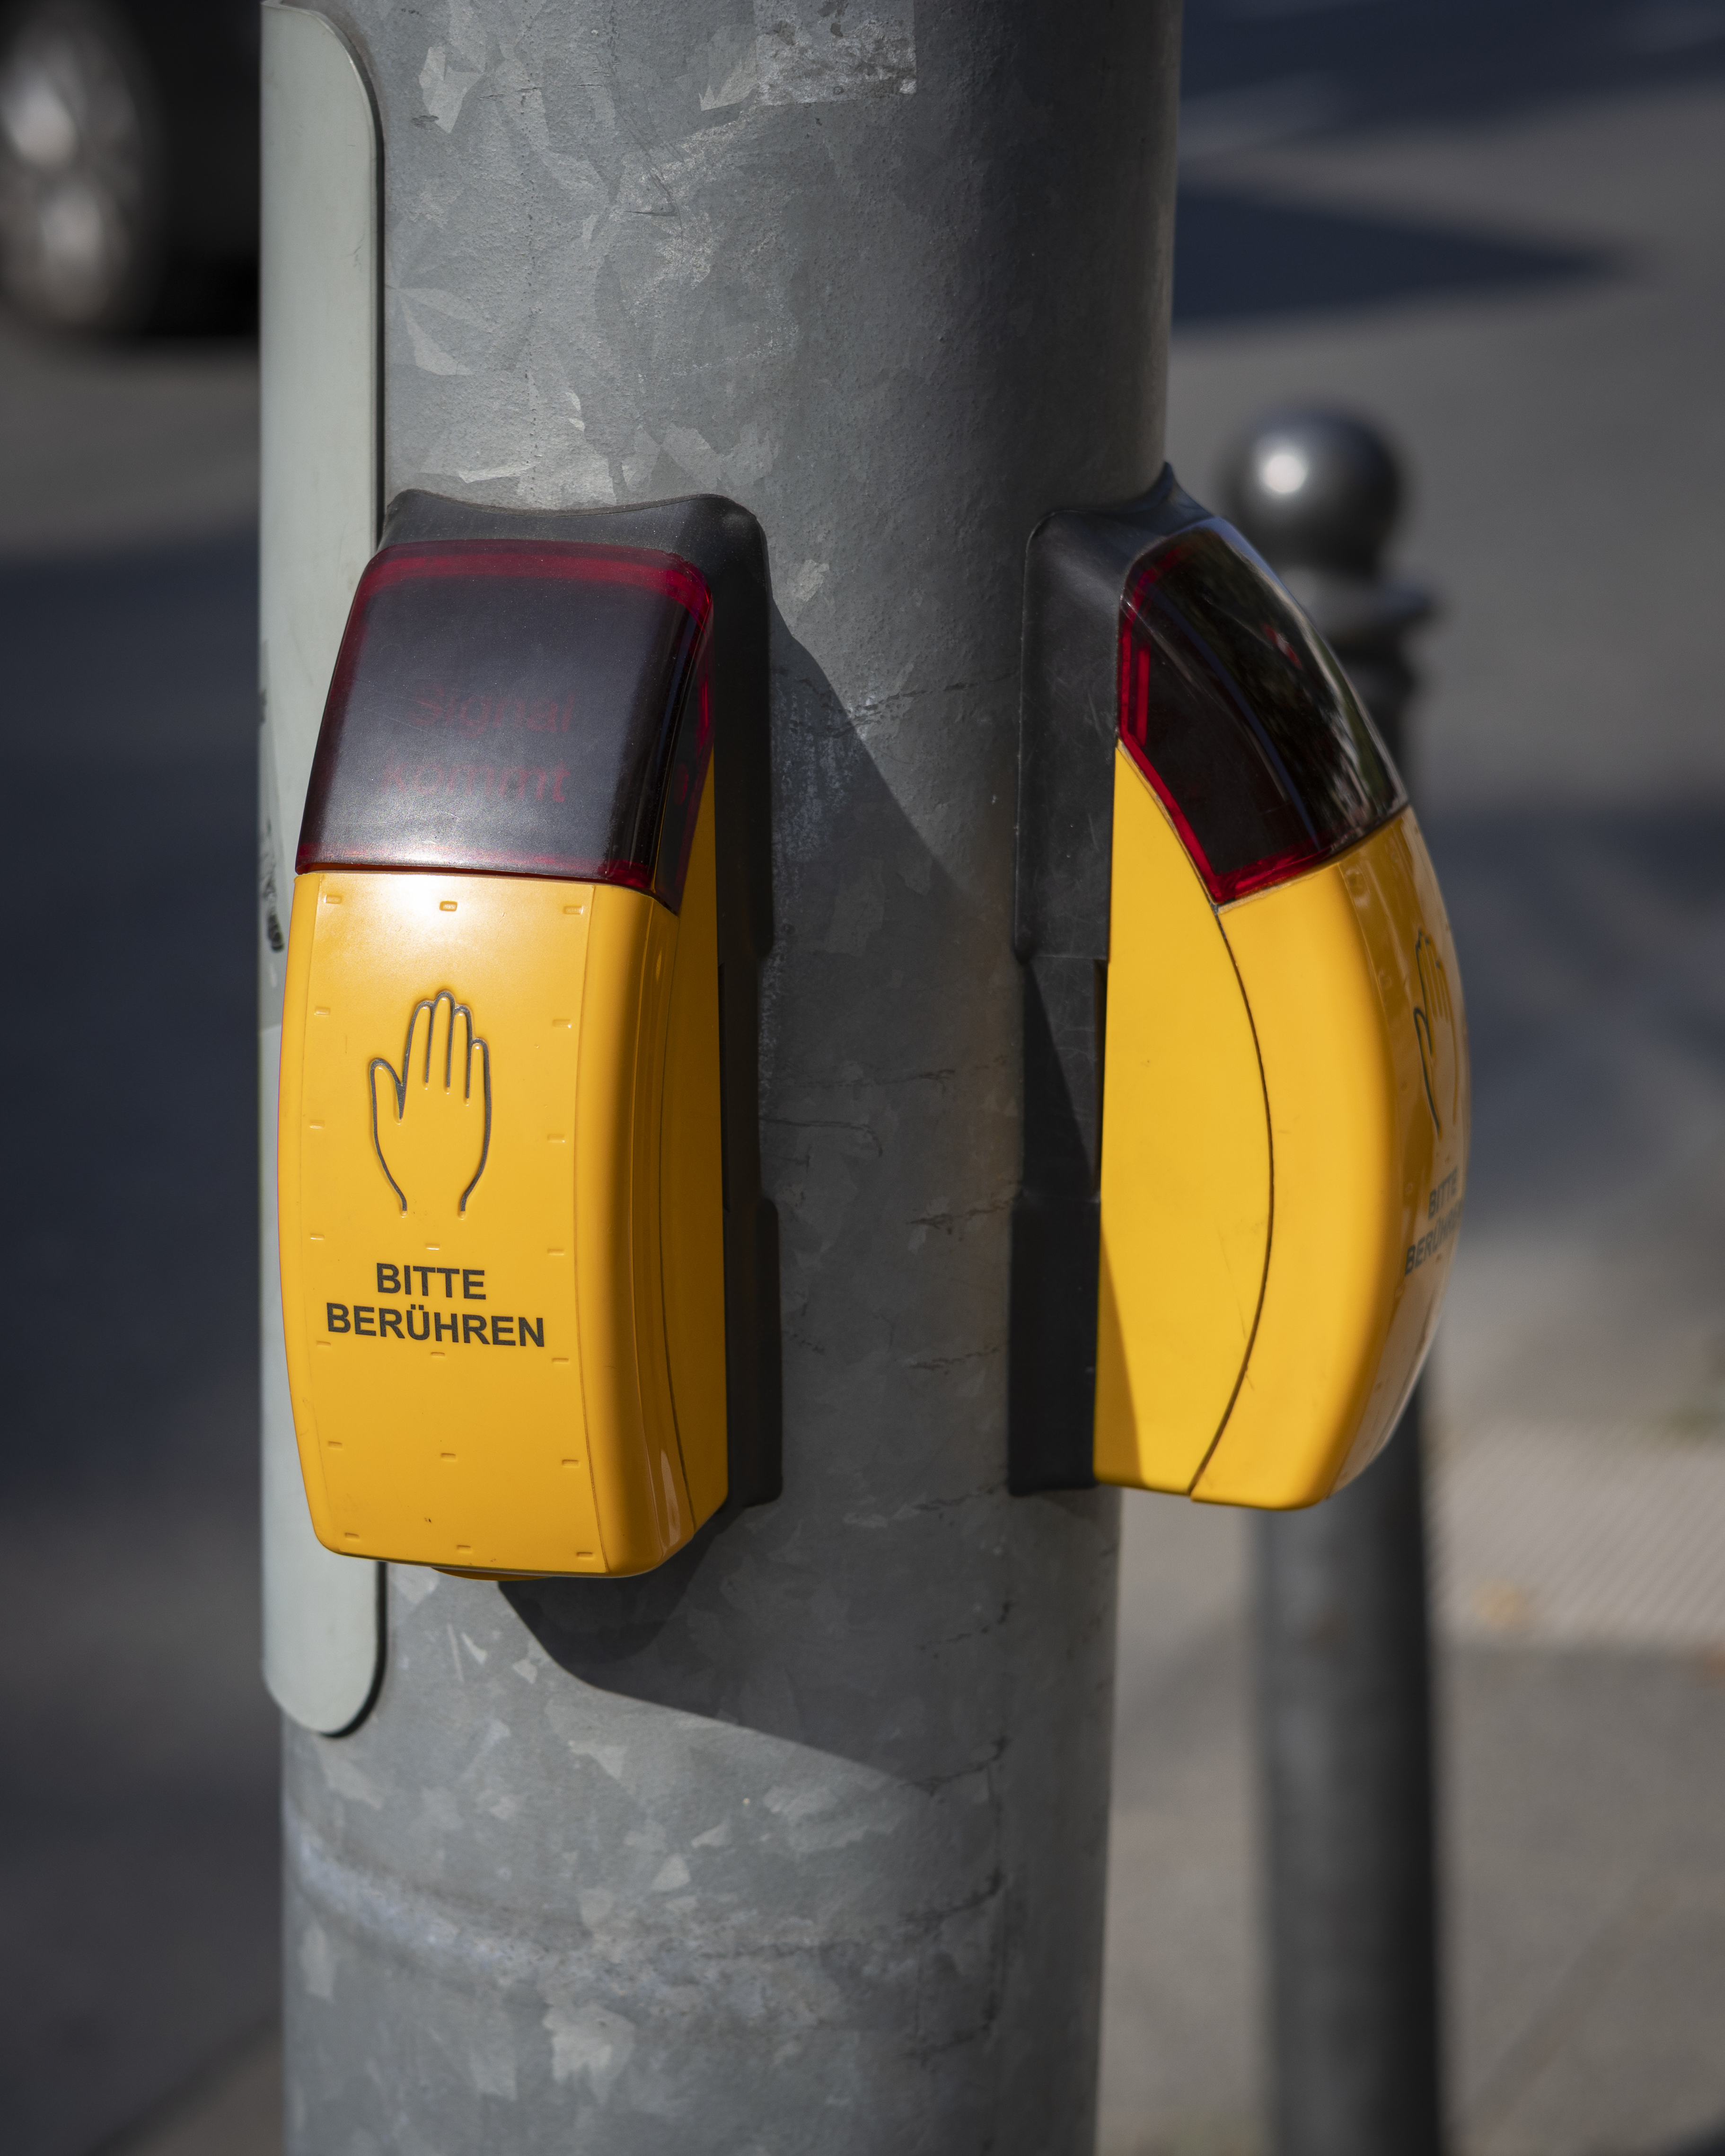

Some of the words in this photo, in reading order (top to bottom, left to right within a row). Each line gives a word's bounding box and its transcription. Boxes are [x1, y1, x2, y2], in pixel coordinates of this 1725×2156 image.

[408, 685, 577, 738] Signal
[380, 748, 571, 803] kommt
[377, 1263, 486, 1300] BITTE
[326, 1302, 545, 1347] BERÜHREN
